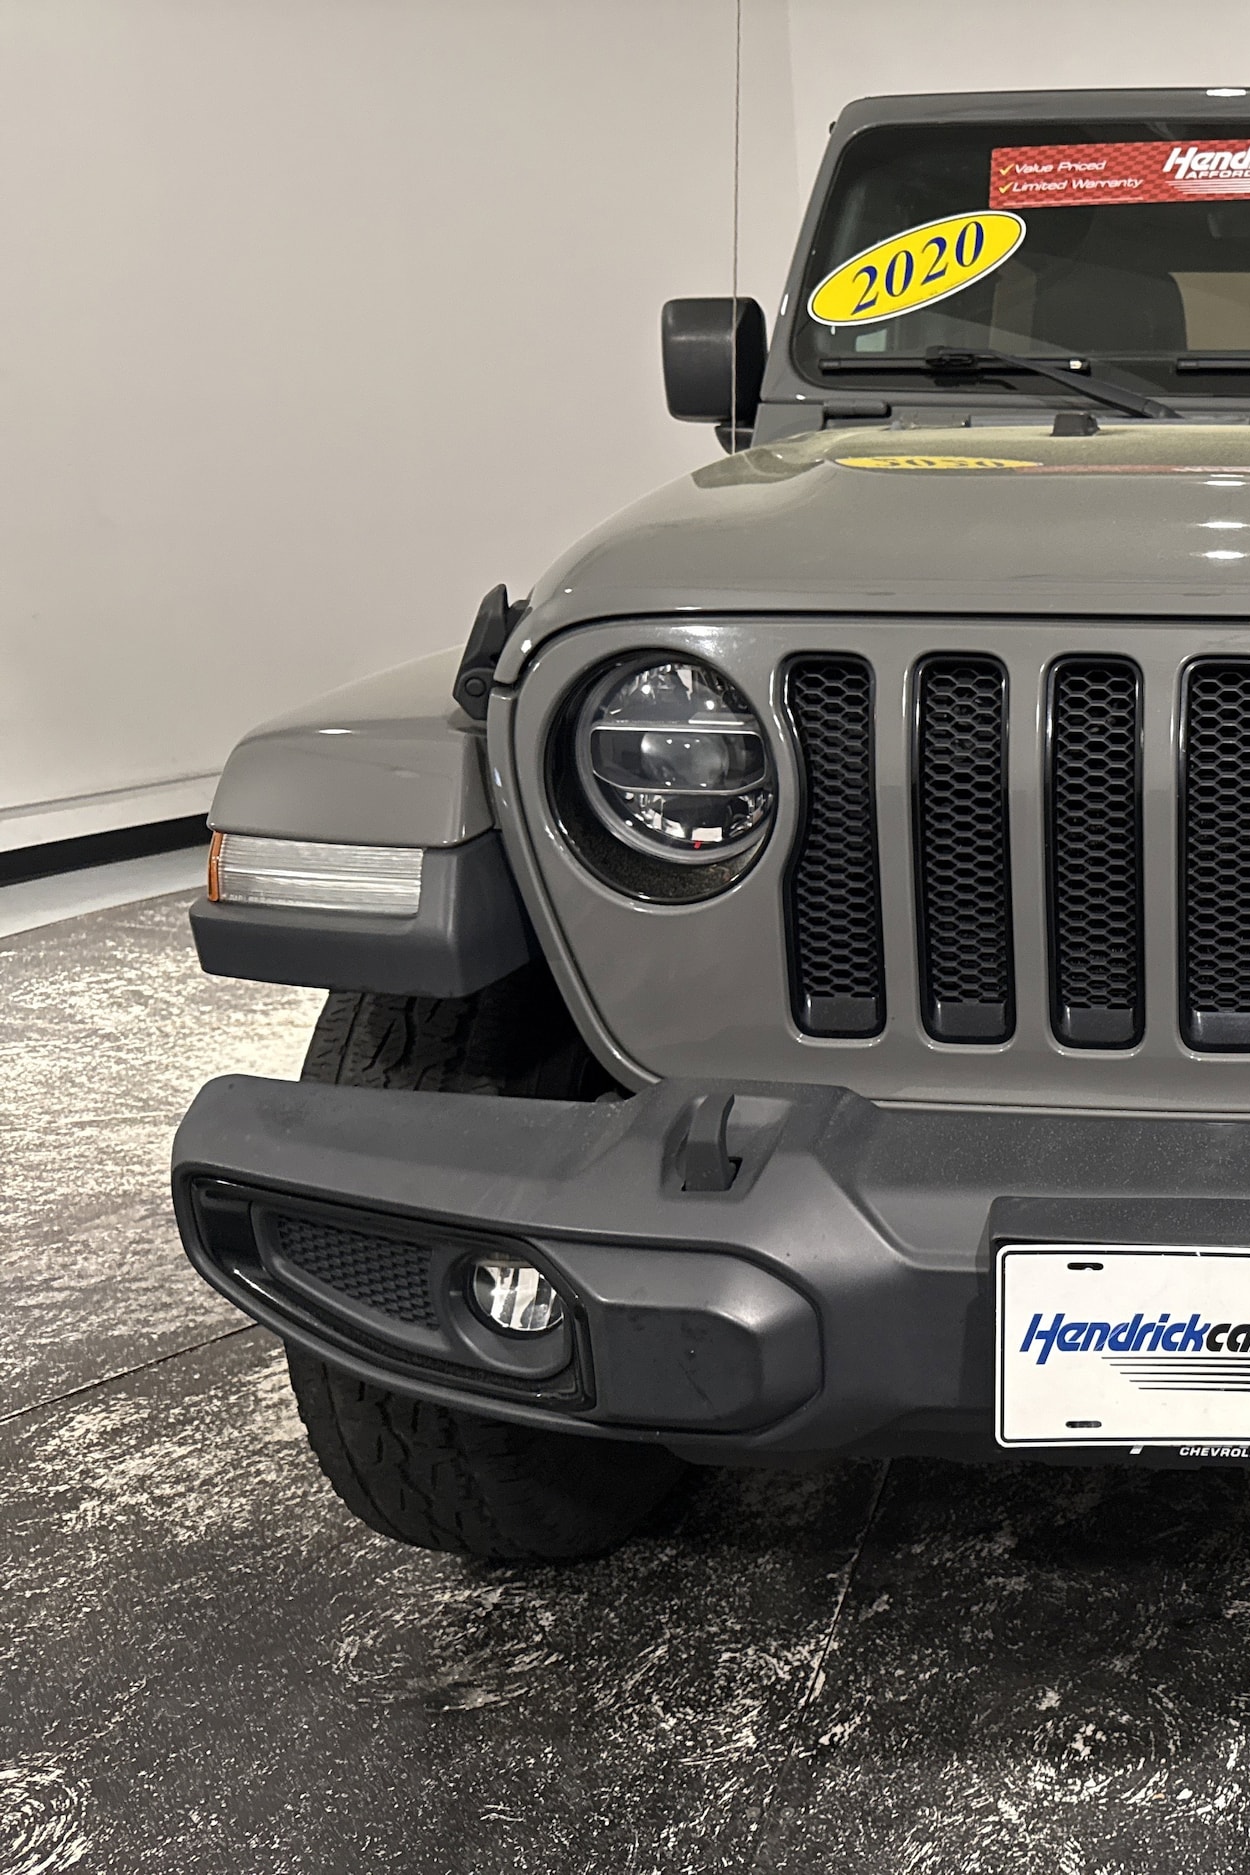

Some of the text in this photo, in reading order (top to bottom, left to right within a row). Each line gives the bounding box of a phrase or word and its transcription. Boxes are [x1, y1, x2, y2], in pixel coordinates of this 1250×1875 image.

[1014, 160, 1107, 174] Value Priced
[1012, 177, 1144, 192] Limited Warranty
[851, 221, 984, 316] 2020
